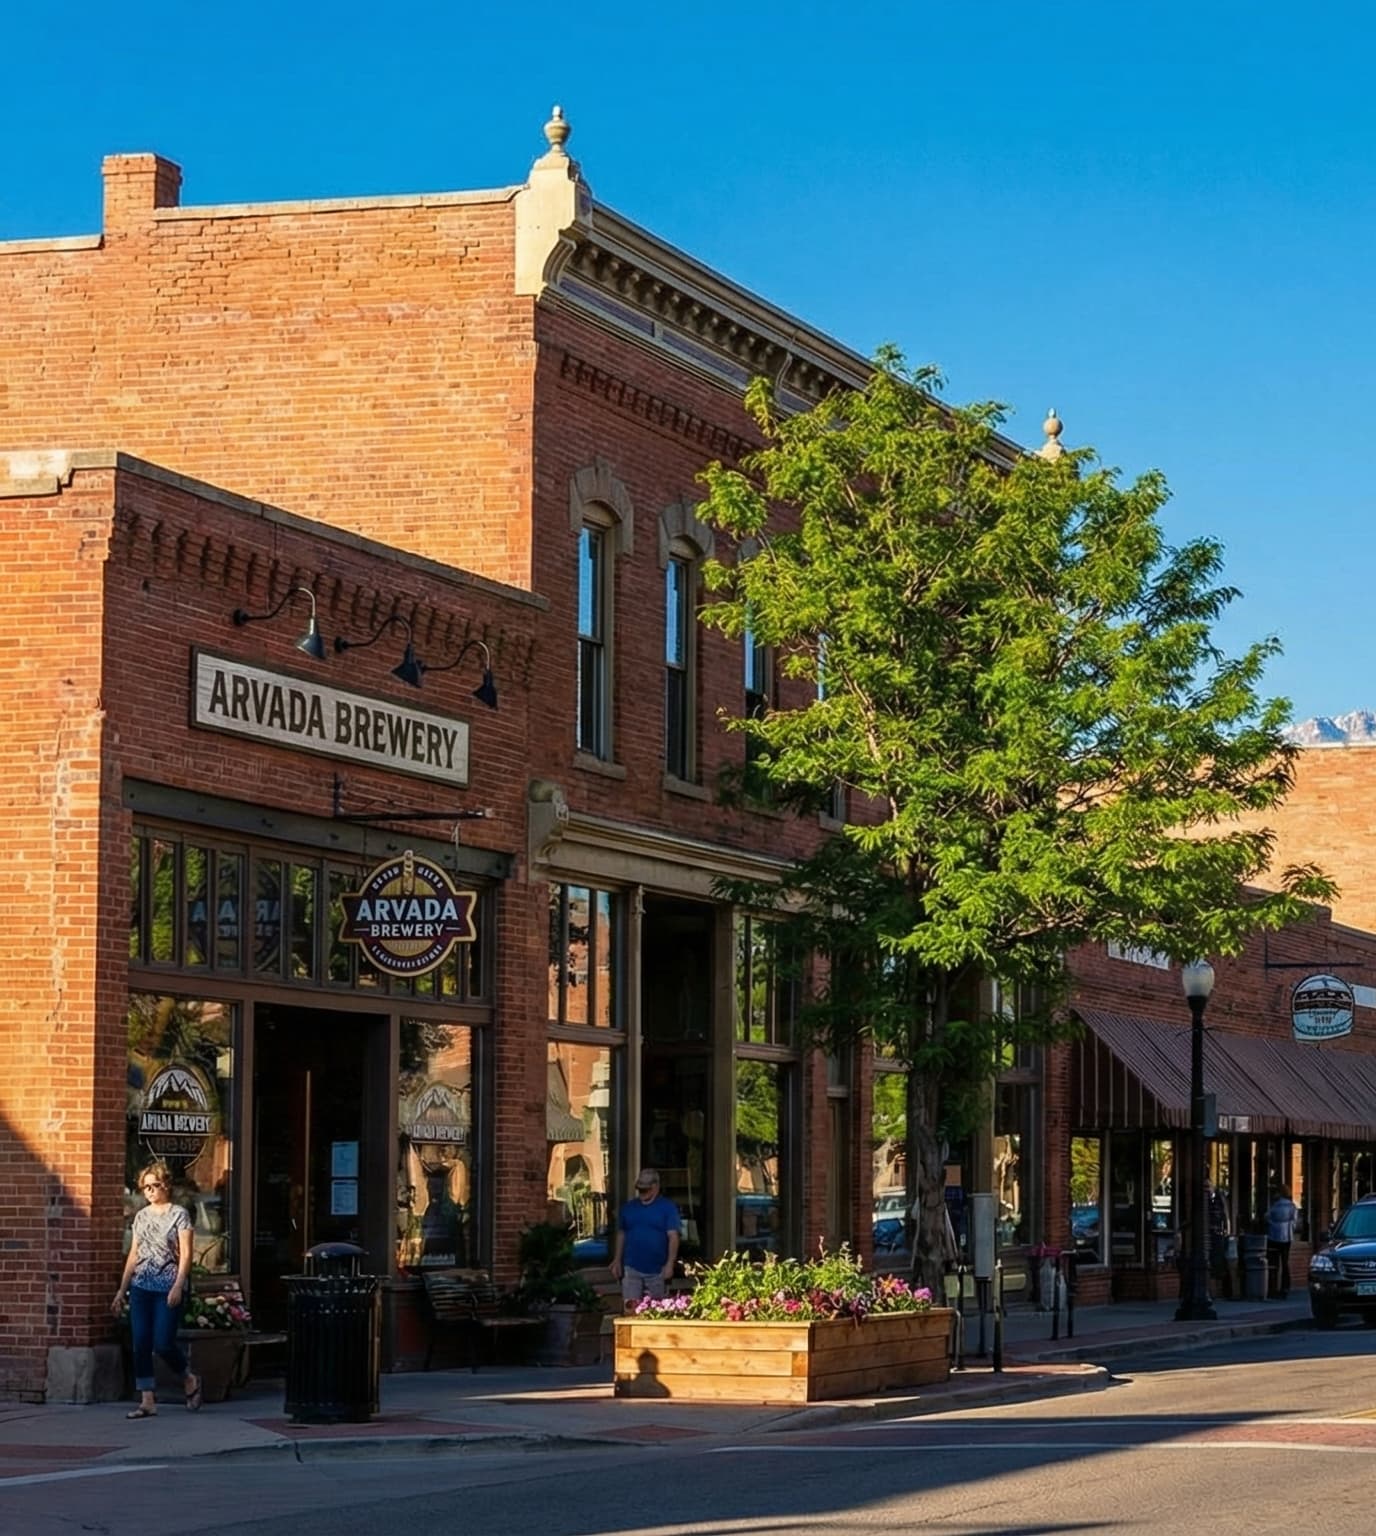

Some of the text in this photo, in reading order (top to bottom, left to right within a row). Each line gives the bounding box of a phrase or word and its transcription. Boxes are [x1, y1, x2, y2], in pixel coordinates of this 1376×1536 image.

[208, 670, 458, 769] ARVADA BREWERY
[356, 898, 459, 921] ARVADA
[371, 923, 444, 937] BREWERY
